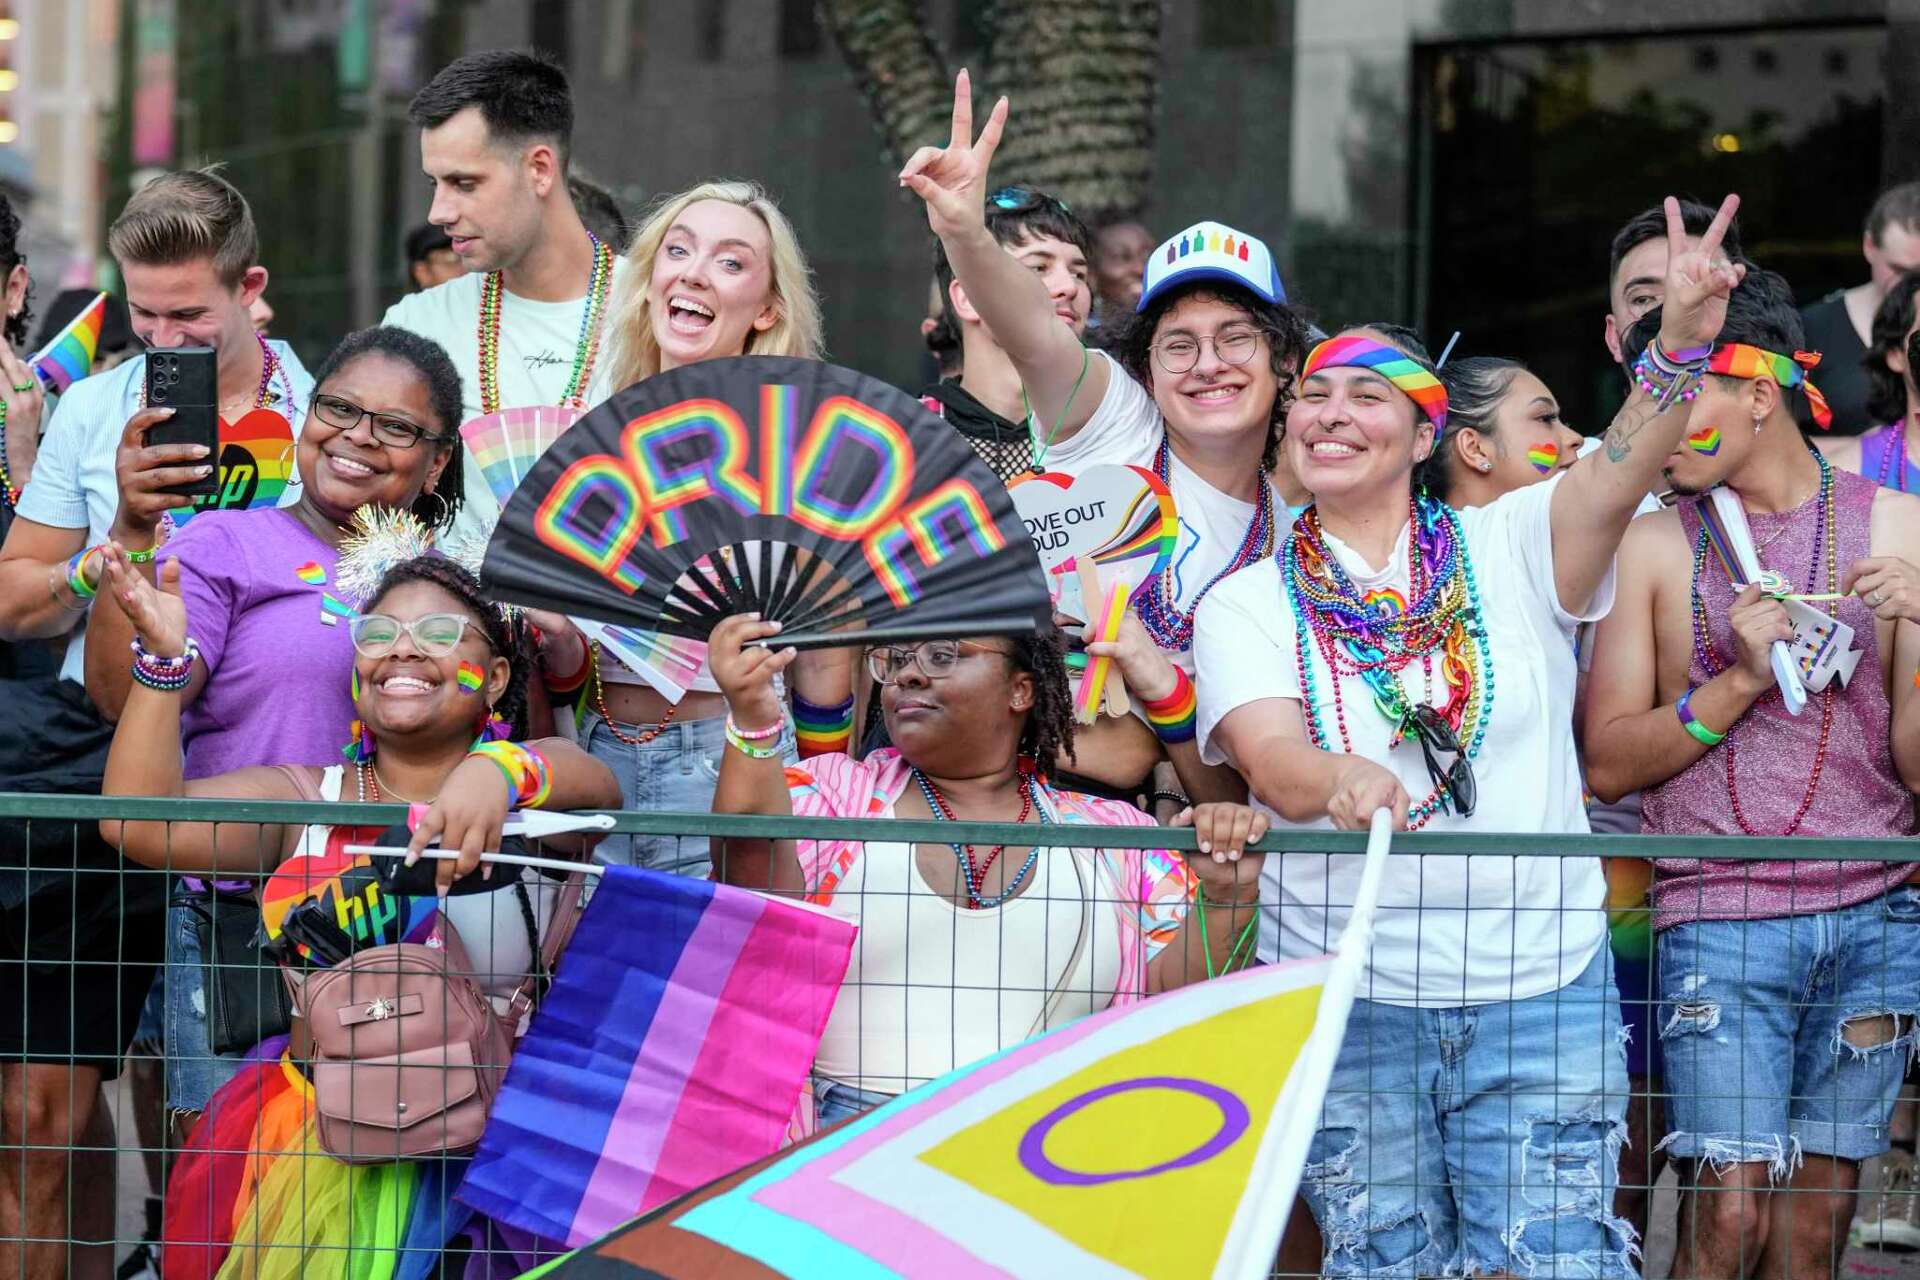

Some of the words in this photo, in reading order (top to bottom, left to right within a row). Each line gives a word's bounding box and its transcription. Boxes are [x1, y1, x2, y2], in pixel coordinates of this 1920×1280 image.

[534, 384, 1006, 608] PRIDE
[1023, 512, 1063, 536] OVE
[1064, 500, 1106, 525] OUT
[1032, 530, 1070, 553] UD
[329, 877, 397, 948] hp
